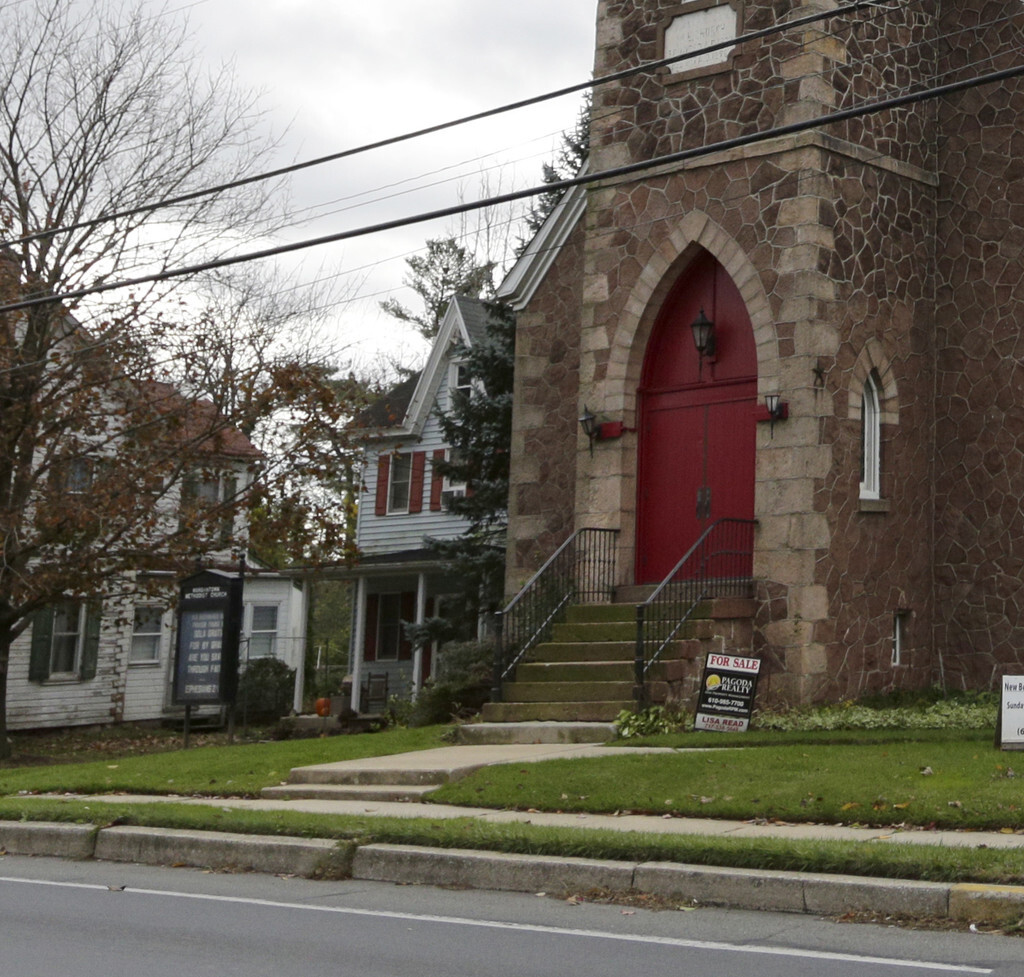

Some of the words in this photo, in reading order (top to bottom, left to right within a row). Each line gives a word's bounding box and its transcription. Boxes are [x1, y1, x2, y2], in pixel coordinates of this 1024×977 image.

[710, 655, 730, 667] FOR
[733, 658, 759, 671] SALE
[721, 676, 753, 687] PAGODA
[1004, 682, 1019, 691] New
[721, 683, 752, 694] REALTY
[701, 716, 720, 724] LISA
[722, 719, 744, 727] READ
